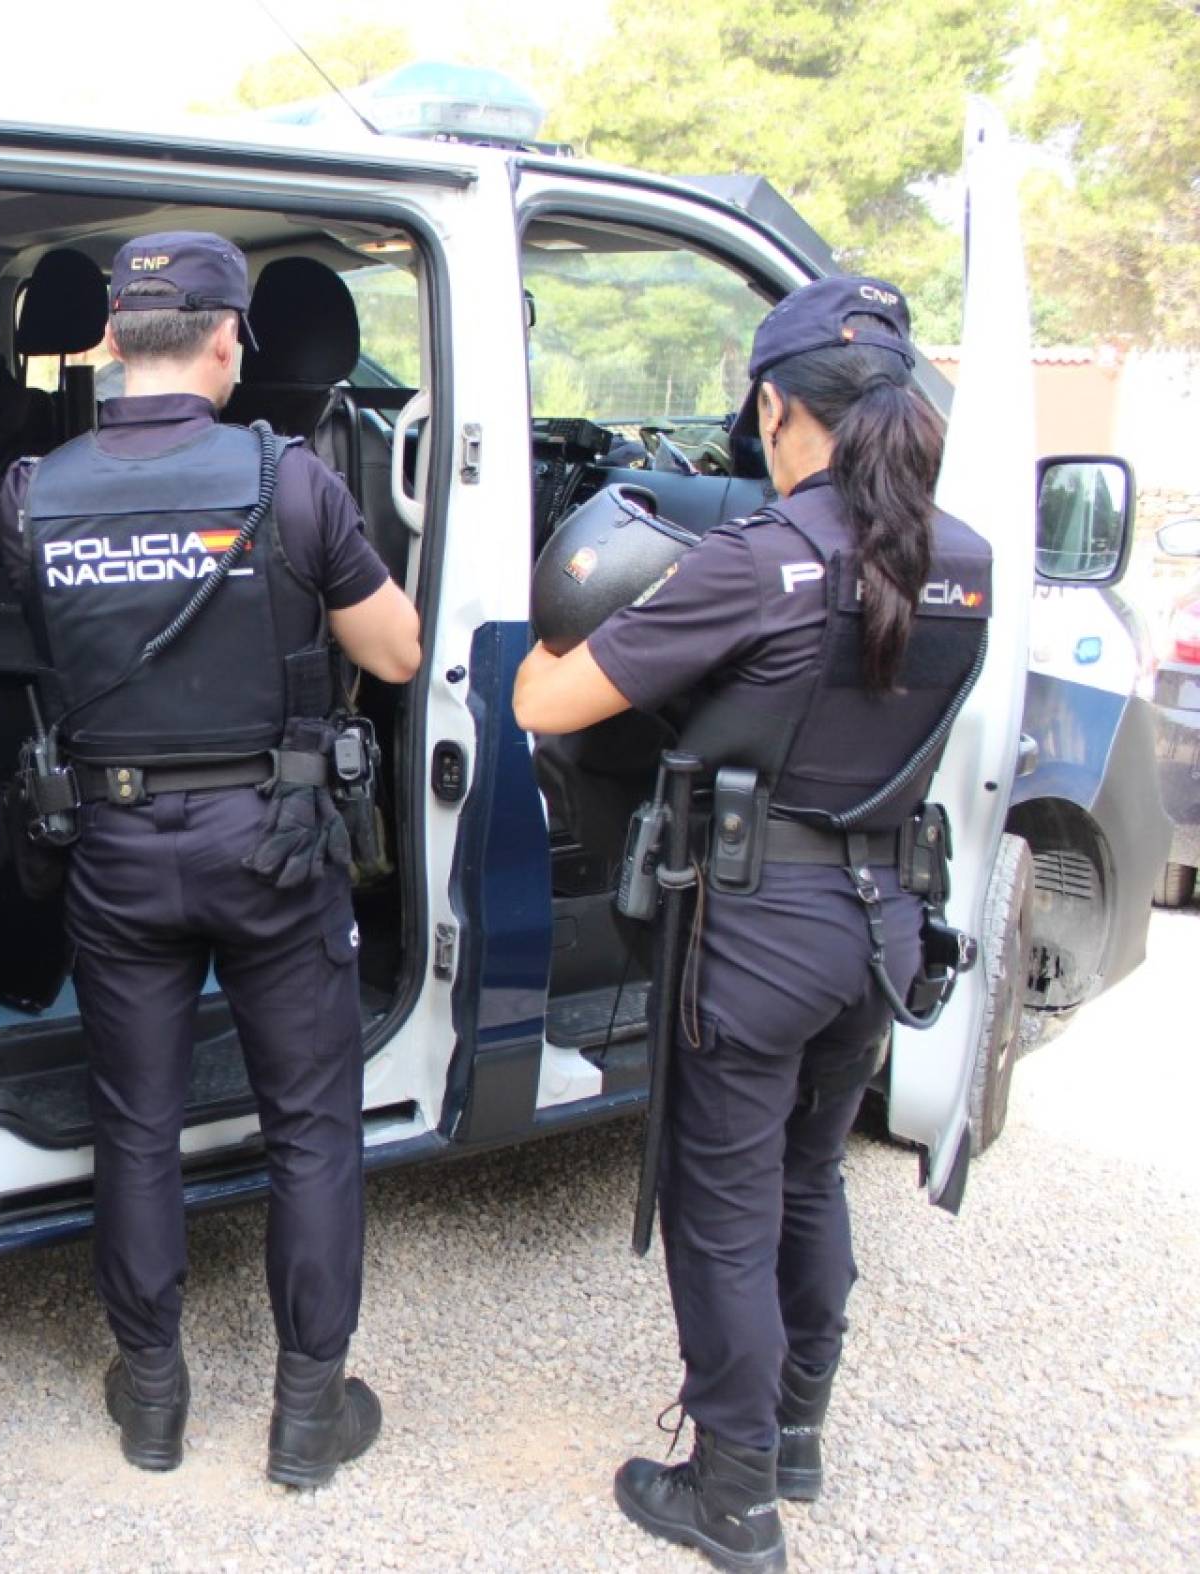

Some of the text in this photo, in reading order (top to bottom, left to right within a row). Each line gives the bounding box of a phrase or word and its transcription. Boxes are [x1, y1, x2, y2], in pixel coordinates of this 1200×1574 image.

[131, 255, 170, 271] CNP
[860, 285, 898, 306] CNP
[44, 531, 208, 565] POLICIA
